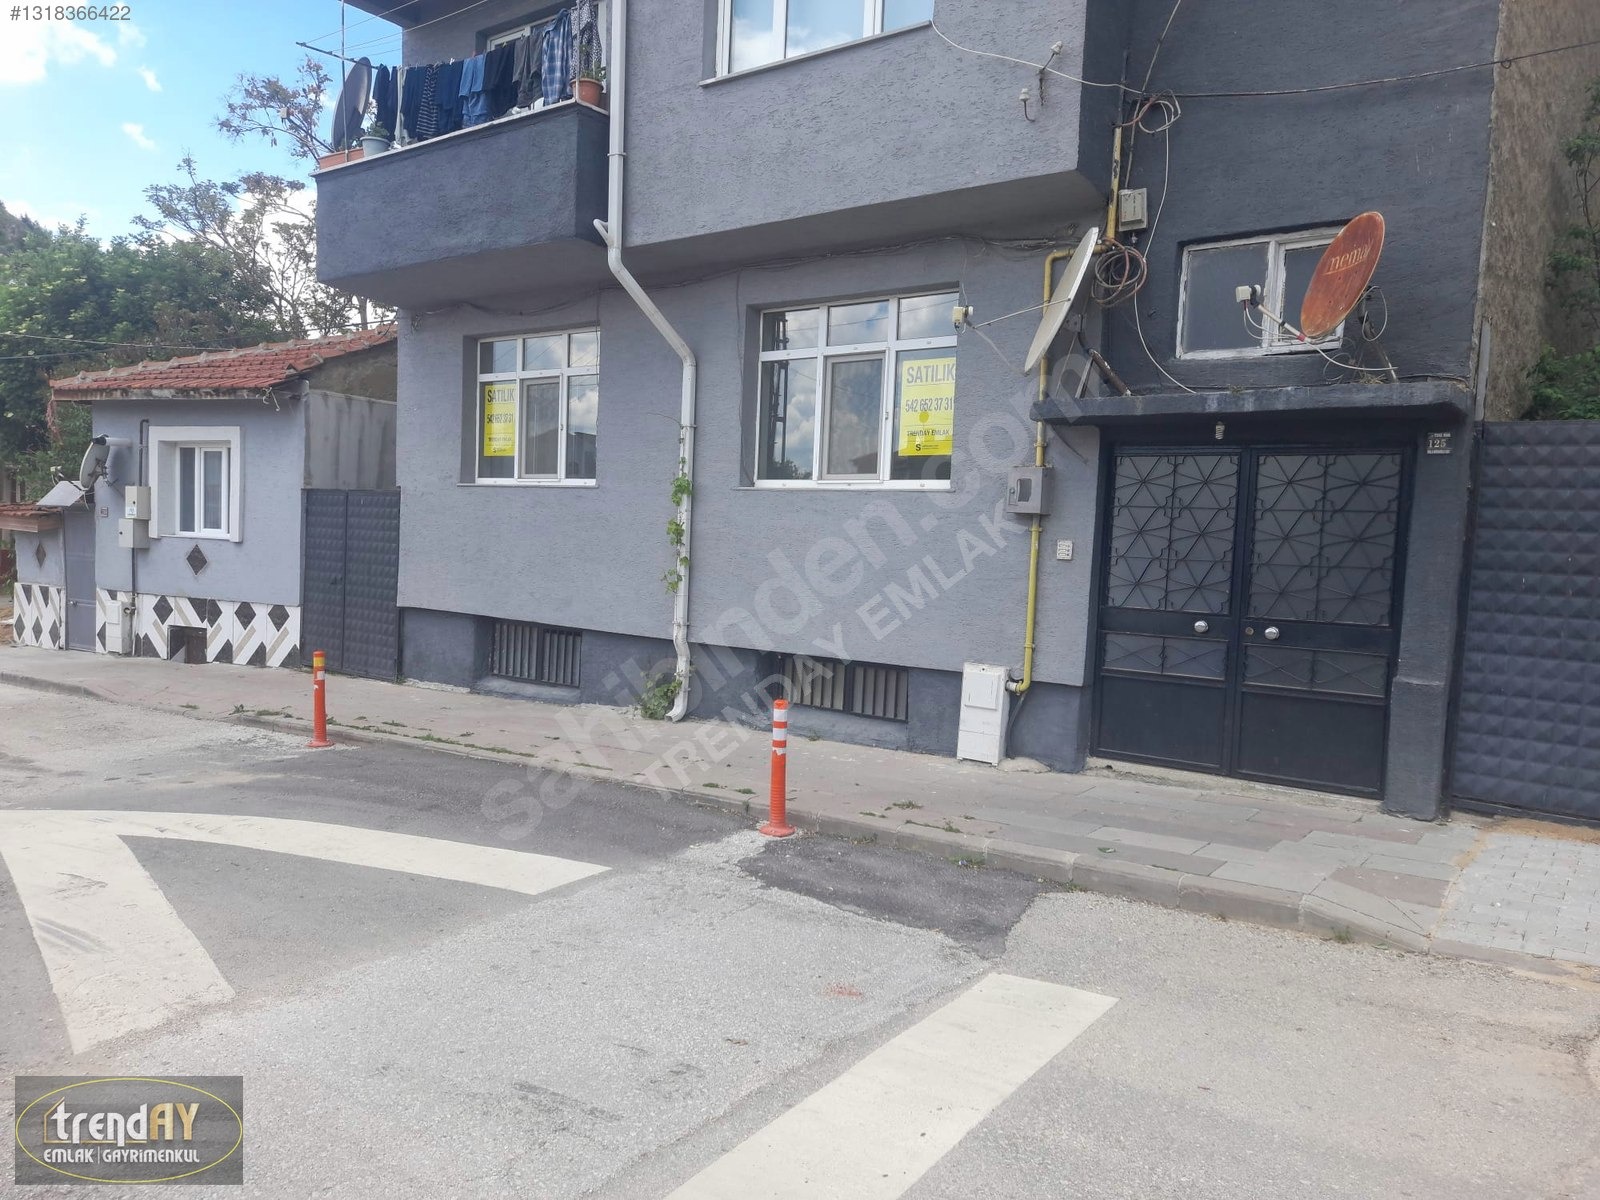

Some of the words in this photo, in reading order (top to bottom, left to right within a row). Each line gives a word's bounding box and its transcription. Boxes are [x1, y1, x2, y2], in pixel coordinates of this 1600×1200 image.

[906, 363, 955, 384] SATILIK
[487, 389, 515, 403] SATILIK
[905, 399, 918, 413] 542
[920, 398, 933, 412] 652
[934, 398, 944, 411] 37
[945, 397, 953, 411] 31
[1429, 439, 1447, 448] 125
